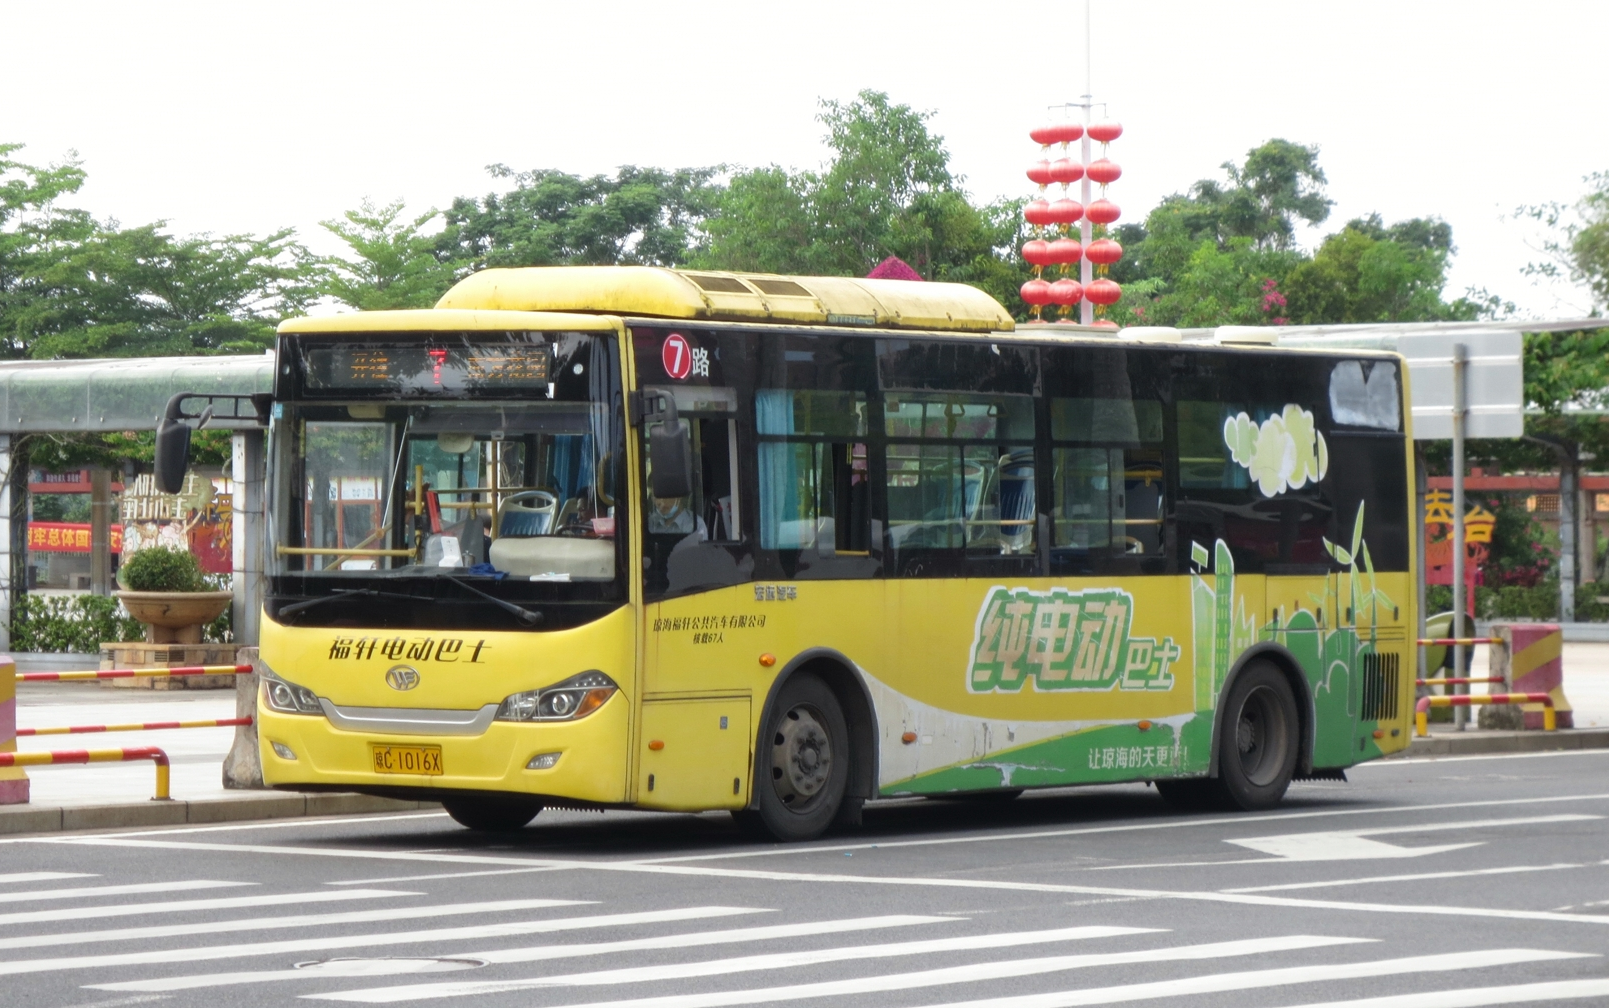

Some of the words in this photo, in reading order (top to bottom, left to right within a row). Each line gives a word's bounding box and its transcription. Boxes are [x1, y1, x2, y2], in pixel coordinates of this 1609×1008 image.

[652, 614, 767, 632] 琼海福轩公共汽车有限公司
[328, 635, 492, 664] 福轩电动巴士
[972, 597, 1180, 689] 纯电动巴士
